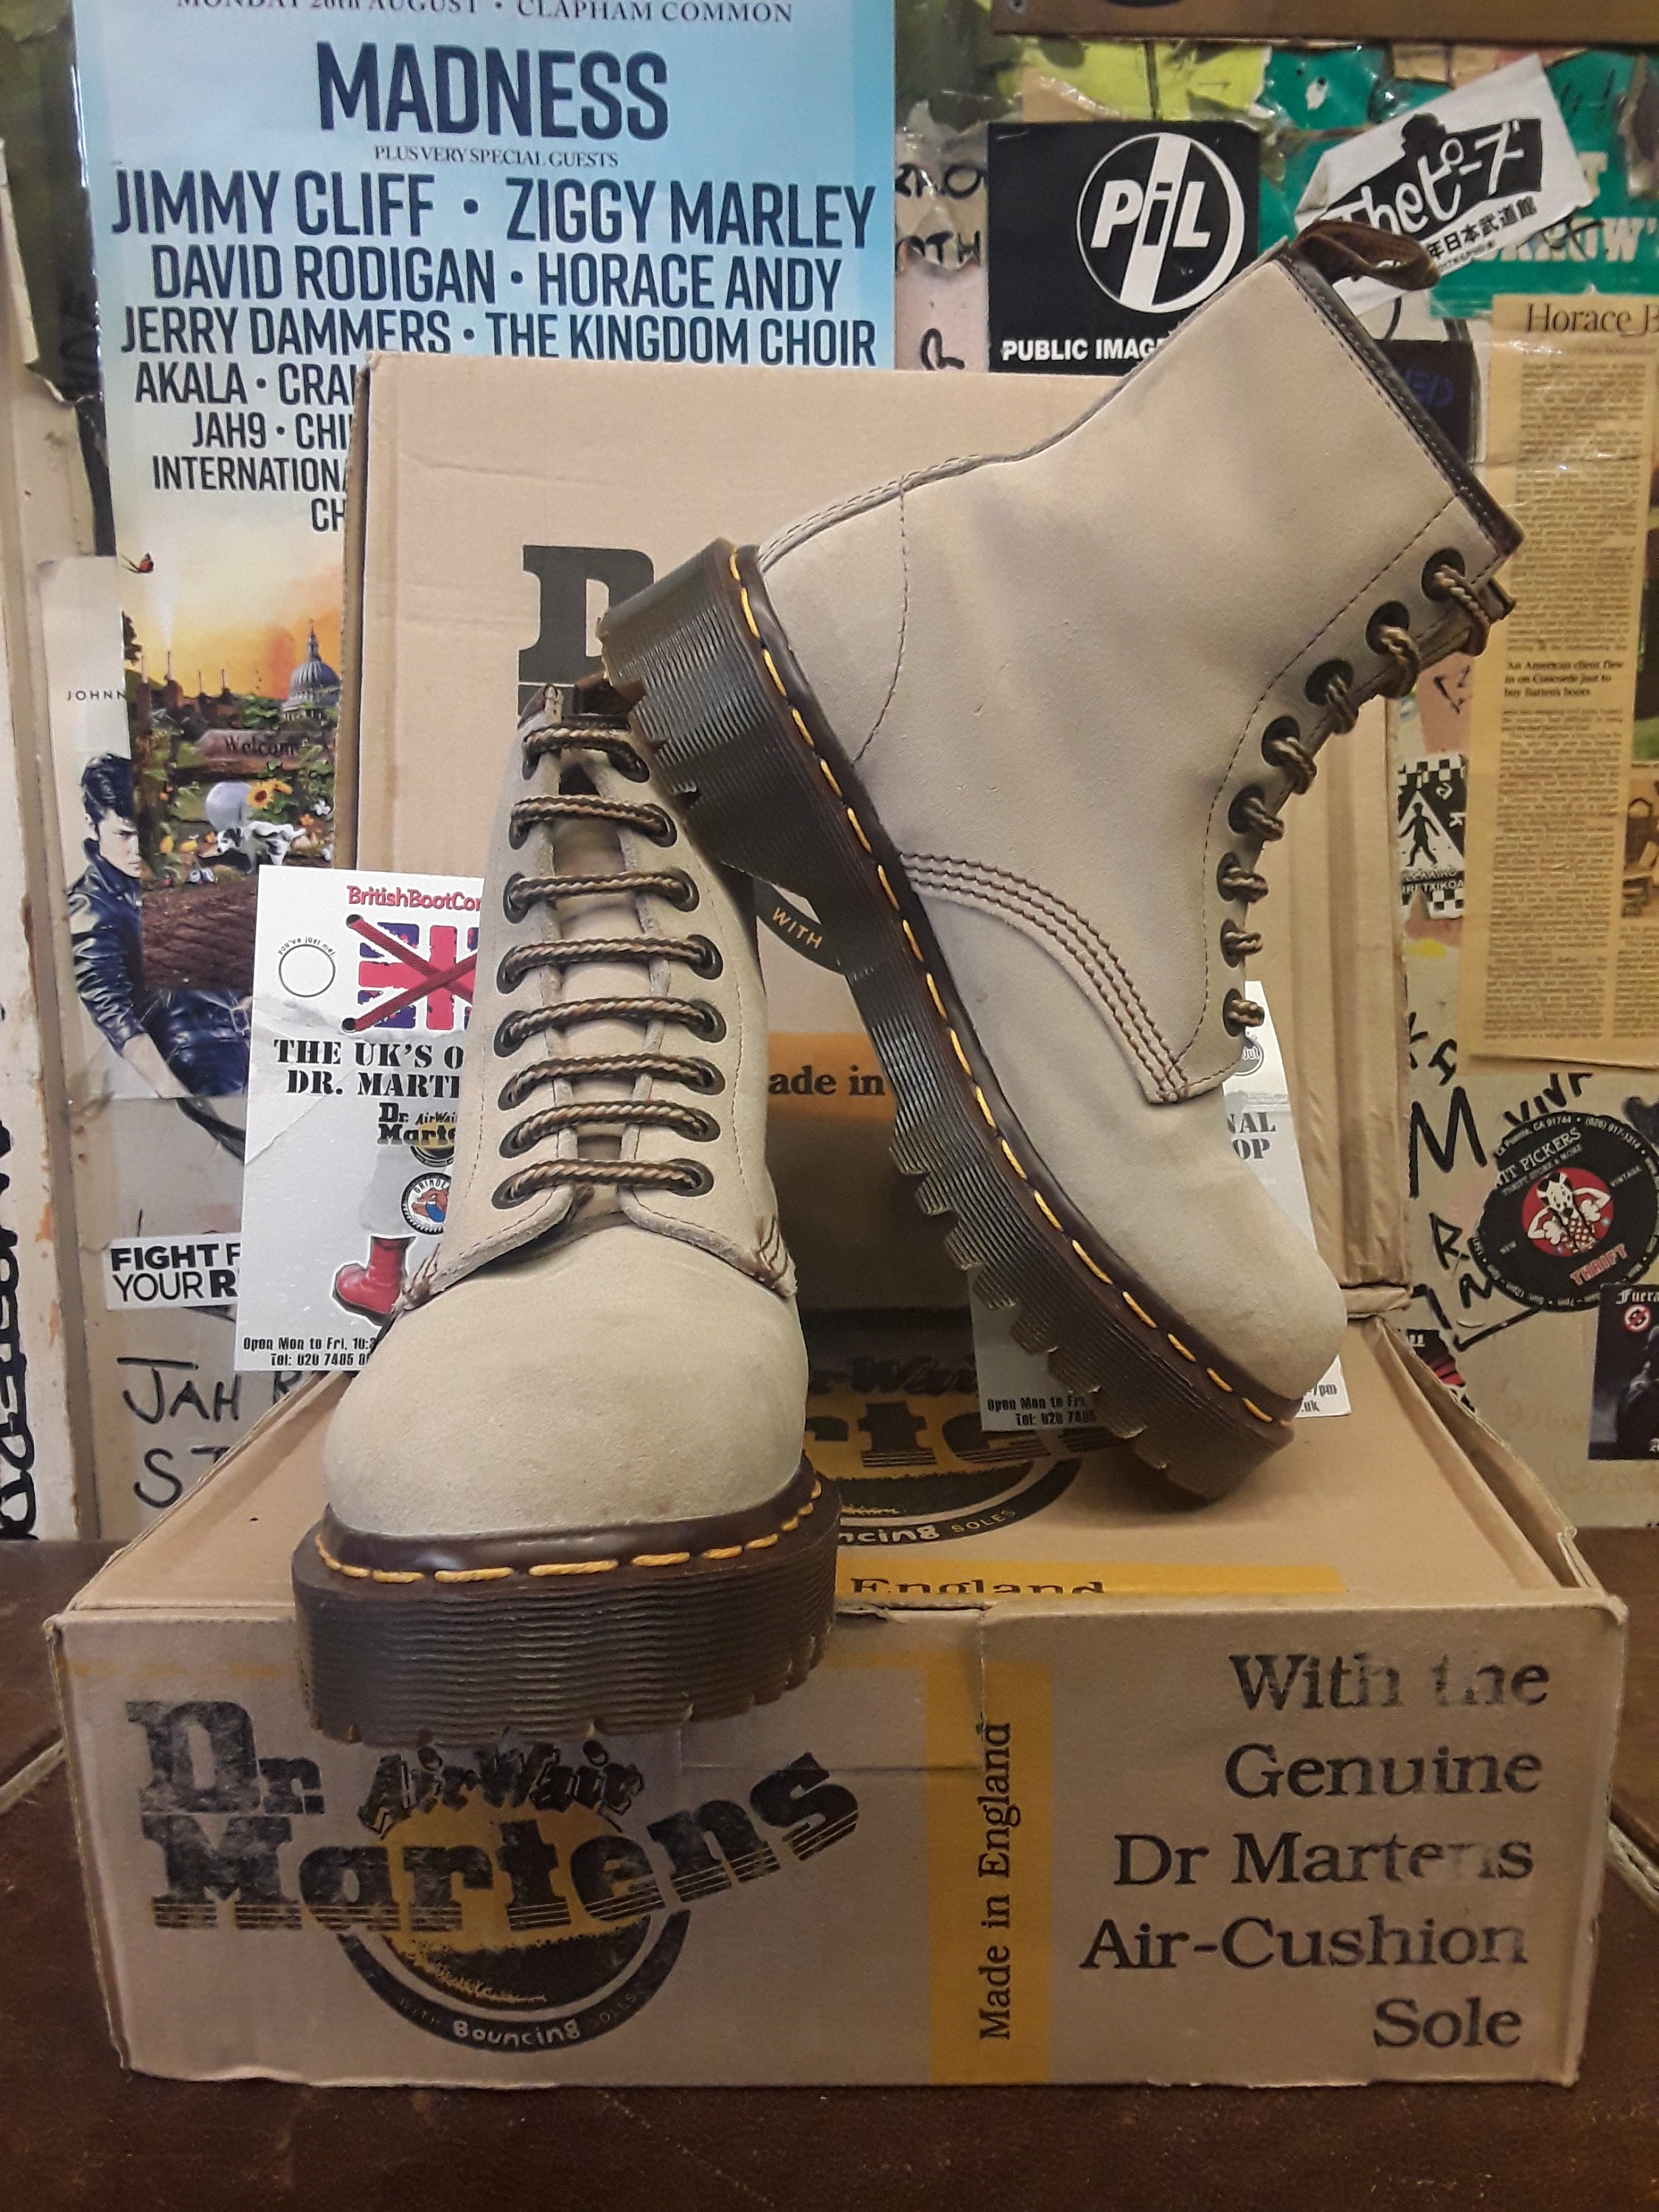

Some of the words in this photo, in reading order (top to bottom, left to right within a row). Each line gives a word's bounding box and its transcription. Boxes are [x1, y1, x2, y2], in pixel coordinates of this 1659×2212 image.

[518, 1, 652, 21] CLAPHAM
[663, 4, 793, 24] COMMON
[316, 41, 669, 141] MADNESS
[375, 145, 418, 161] PLUS
[419, 147, 467, 163] VERY
[469, 149, 546, 167] SPECIAL
[549, 152, 619, 168] GUESTS
[111, 169, 280, 234] JIMMY
[295, 170, 435, 237] CLIFF
[505, 176, 656, 244] ZIGGY
[670, 180, 877, 249] MARLEY
[151, 243, 282, 299] DAVID
[295, 245, 496, 305] RODIGAN
[538, 252, 714, 310] HORACE
[725, 257, 842, 313] ANDY
[1526, 303, 1632, 333] Horace
[121, 307, 239, 354] JERRY
[250, 307, 451, 355] DAMMERS
[485, 312, 559, 359] THE
[571, 313, 748, 366] KINGDOM
[760, 319, 877, 367] CHOIR
[1002, 339, 1088, 361] PUBLIC
[1096, 337, 1169, 361] IMAG
[135, 361, 248, 404] AKALA
[192, 411, 267, 448] JAH9
[296, 413, 353, 451] CHI
[153, 455, 347, 492] INTERNATION
[311, 498, 346, 532] CH
[1505, 674, 1514, 683] in
[1533, 674, 1579, 684] Concorde
[1580, 674, 1598, 685] just
[1601, 674, 1611, 683] to
[1508, 661, 1521, 669] An
[1524, 661, 1571, 670] American
[1574, 660, 1600, 669] client
[1604, 660, 1624, 669] flew
[66, 689, 126, 702] JOHNN
[1504, 687, 1521, 698] buy
[1563, 687, 1591, 697] boots
[305, 936, 321, 946] just
[773, 907, 823, 949] WITH
[274, 1039, 341, 1065] THE
[355, 1043, 432, 1069] UK'S
[444, 1045, 463, 1068] O
[286, 1069, 344, 1096] DR.
[357, 1072, 460, 1099] MART
[768, 1065, 836, 1095] ade
[848, 1065, 886, 1096] in
[1227, 1112, 1276, 1134] NAL
[1533, 1120, 1546, 1132] CA
[1232, 1138, 1270, 1161] OP
[1520, 1127, 1582, 1171] PICKERS
[111, 1243, 219, 1272] FIGHT
[226, 1242, 241, 1266] F
[1570, 1242, 1628, 1286] THRIFT
[113, 1270, 204, 1303] YOUR
[209, 1269, 239, 1298] R
[243, 1337, 274, 1352] Open
[278, 1337, 305, 1351] Mon
[310, 1338, 322, 1350] to
[327, 1337, 347, 1351] Fri,
[271, 1353, 292, 1366] Tel:
[297, 1353, 319, 1366] 020
[987, 1398, 1017, 1413] Open
[1020, 1397, 1046, 1410] Mon
[1051, 1396, 1063, 1408] to
[1016, 1413, 1037, 1426] Tel:
[840, 1524, 941, 1545] ncing
[951, 1508, 1016, 1533] SOLES
[1228, 1652, 1404, 1711] With
[1225, 1742, 1543, 1800] Genuine
[977, 1719, 1023, 1879] England
[141, 1750, 859, 1933] Martens
[1113, 1833, 1210, 1886] Dr
[981, 1894, 1010, 1930] in
[1079, 1915, 1528, 1970] Air-Cushion
[979, 1945, 1011, 2041] Made
[452, 2018, 580, 2047] Bouncing
[596, 1992, 637, 2024] OLES
[1373, 1995, 1523, 2048] Sole
